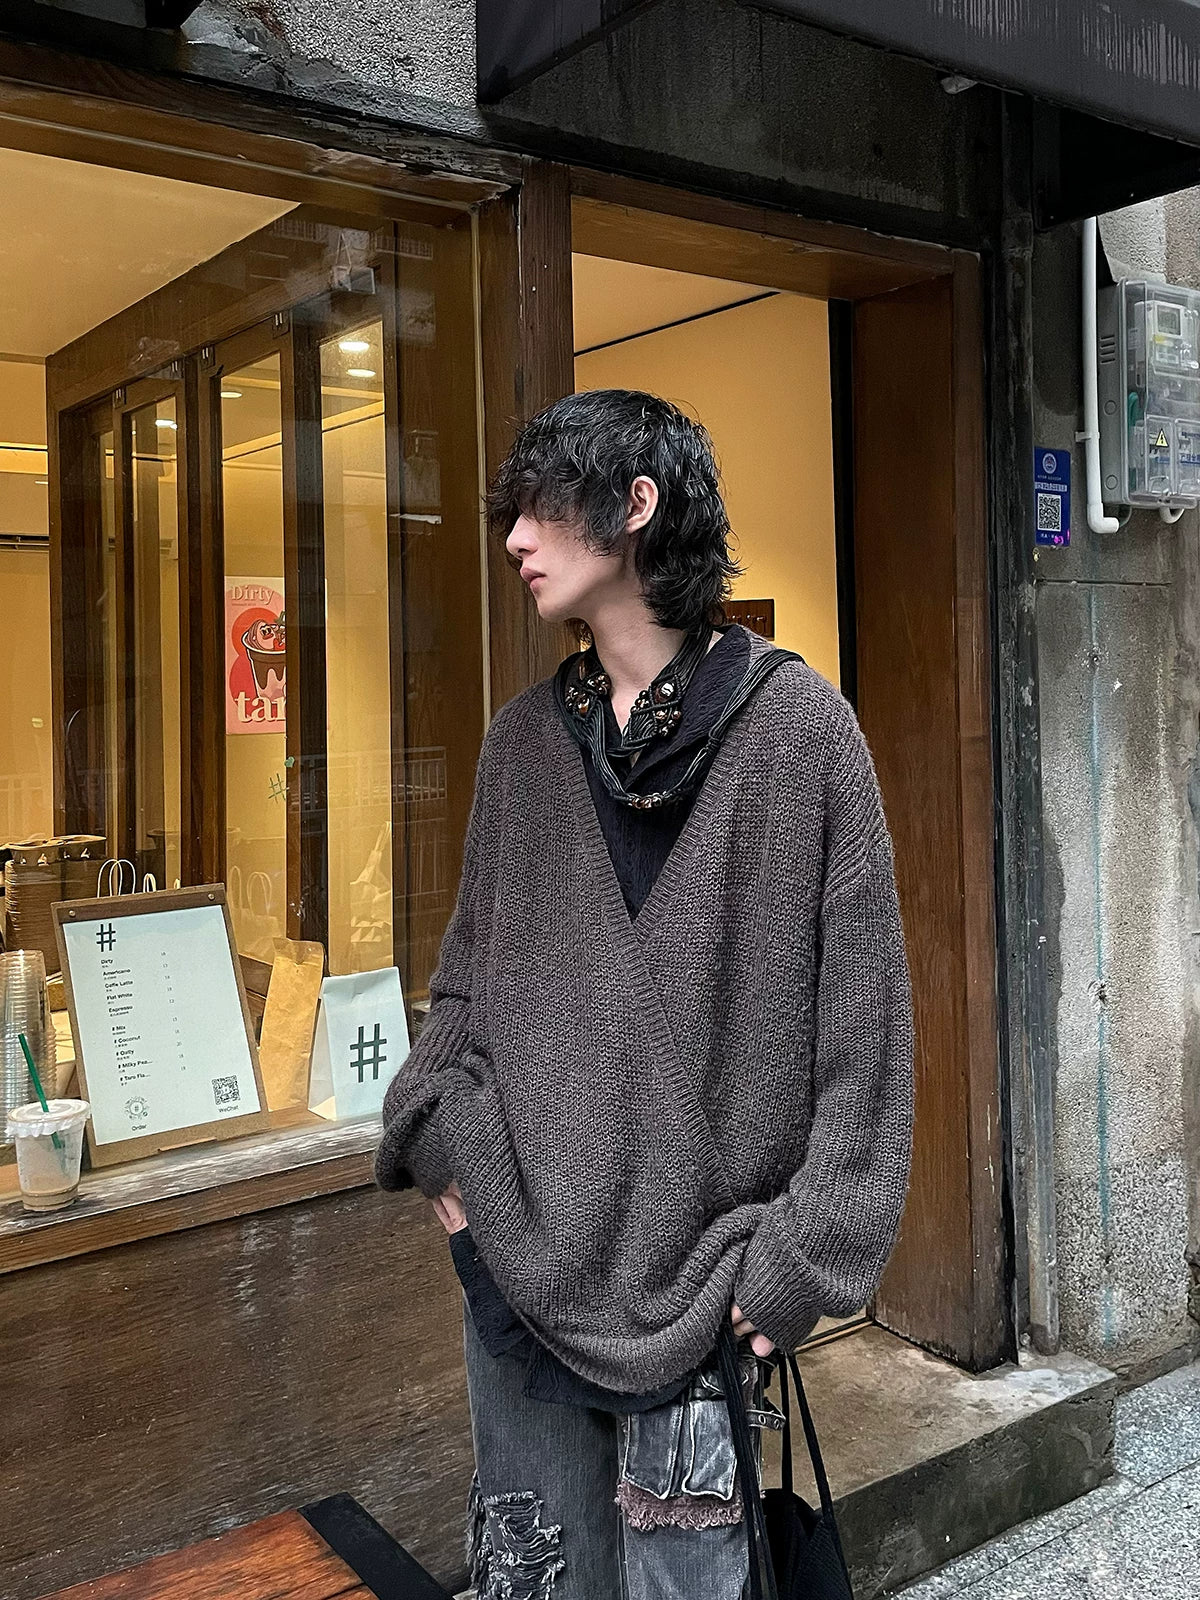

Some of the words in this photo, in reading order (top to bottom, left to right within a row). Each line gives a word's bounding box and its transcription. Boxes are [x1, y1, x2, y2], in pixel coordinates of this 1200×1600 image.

[231, 584, 275, 606] Dirty
[96, 923, 116, 952] #
[118, 1035, 141, 1043] Coconut
[350, 1023, 387, 1083] #
[131, 1123, 147, 1131] Order
